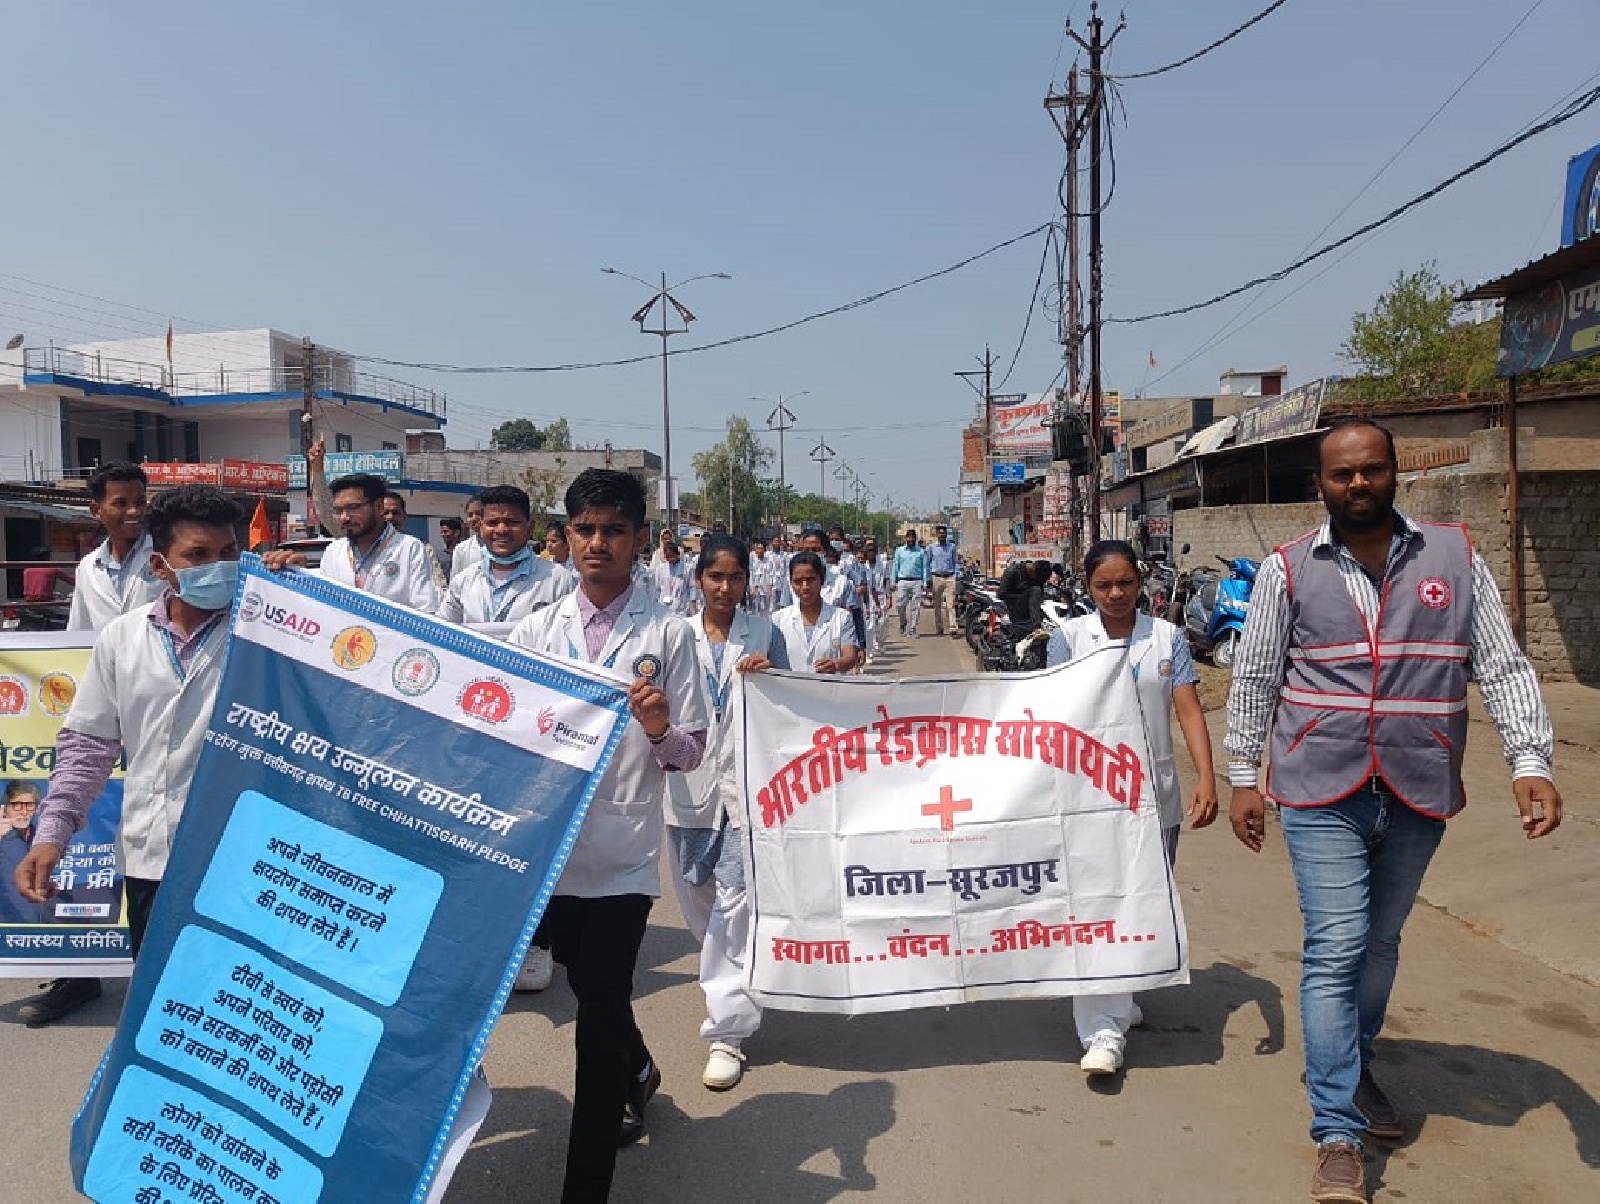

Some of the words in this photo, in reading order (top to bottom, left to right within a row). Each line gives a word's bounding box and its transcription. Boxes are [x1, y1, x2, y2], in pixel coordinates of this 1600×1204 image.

[264, 605, 321, 637] USAID
[226, 702, 294, 745] राष्ट्रीय
[290, 731, 333, 761] क्षय
[330, 746, 421, 797] उन्मूलन
[417, 781, 520, 836] कार्यक्रम
[756, 722, 868, 830] भारतीय
[995, 708, 1145, 814] सोसायटी
[336, 785, 351, 800] TB
[352, 792, 381, 813] FREE
[379, 804, 479, 853] CHHATTISGARH
[475, 844, 530, 873] PLEDGE
[252, 858, 301, 893] क्षयरोग
[298, 881, 347, 915] समाप्त
[346, 903, 387, 933] करने
[266, 837, 301, 863] अपने
[300, 852, 378, 896] जीवनकाल
[375, 883, 397, 905] में
[5, 933, 65, 949] स्वास्थ्य
[256, 889, 277, 911] की
[274, 902, 313, 930] शपथ
[311, 915, 340, 942] लेते
[213, 989, 253, 1018] अपने
[252, 1006, 293, 1043] परिवार
[261, 980, 275, 1000] से
[272, 988, 305, 1017] स्वयं
[159, 1028, 186, 1049] को
[184, 1037, 228, 1069] बचाने
[226, 1057, 250, 1081] की
[247, 1071, 281, 1103] शपथ
[279, 1089, 306, 1119] लेते
[161, 999, 205, 1027] अपने
[256, 1042, 277, 1066] को
[275, 1054, 302, 1082] और
[122, 1116, 156, 1143] सही
[153, 1130, 197, 1161] तरीके
[195, 1151, 218, 1175] का
[217, 1164, 260, 1201] पालन
[139, 1152, 160, 1175] के
[156, 1161, 192, 1190] लिए
[200, 1121, 224, 1145] को
[265, 1156, 283, 1180] के
